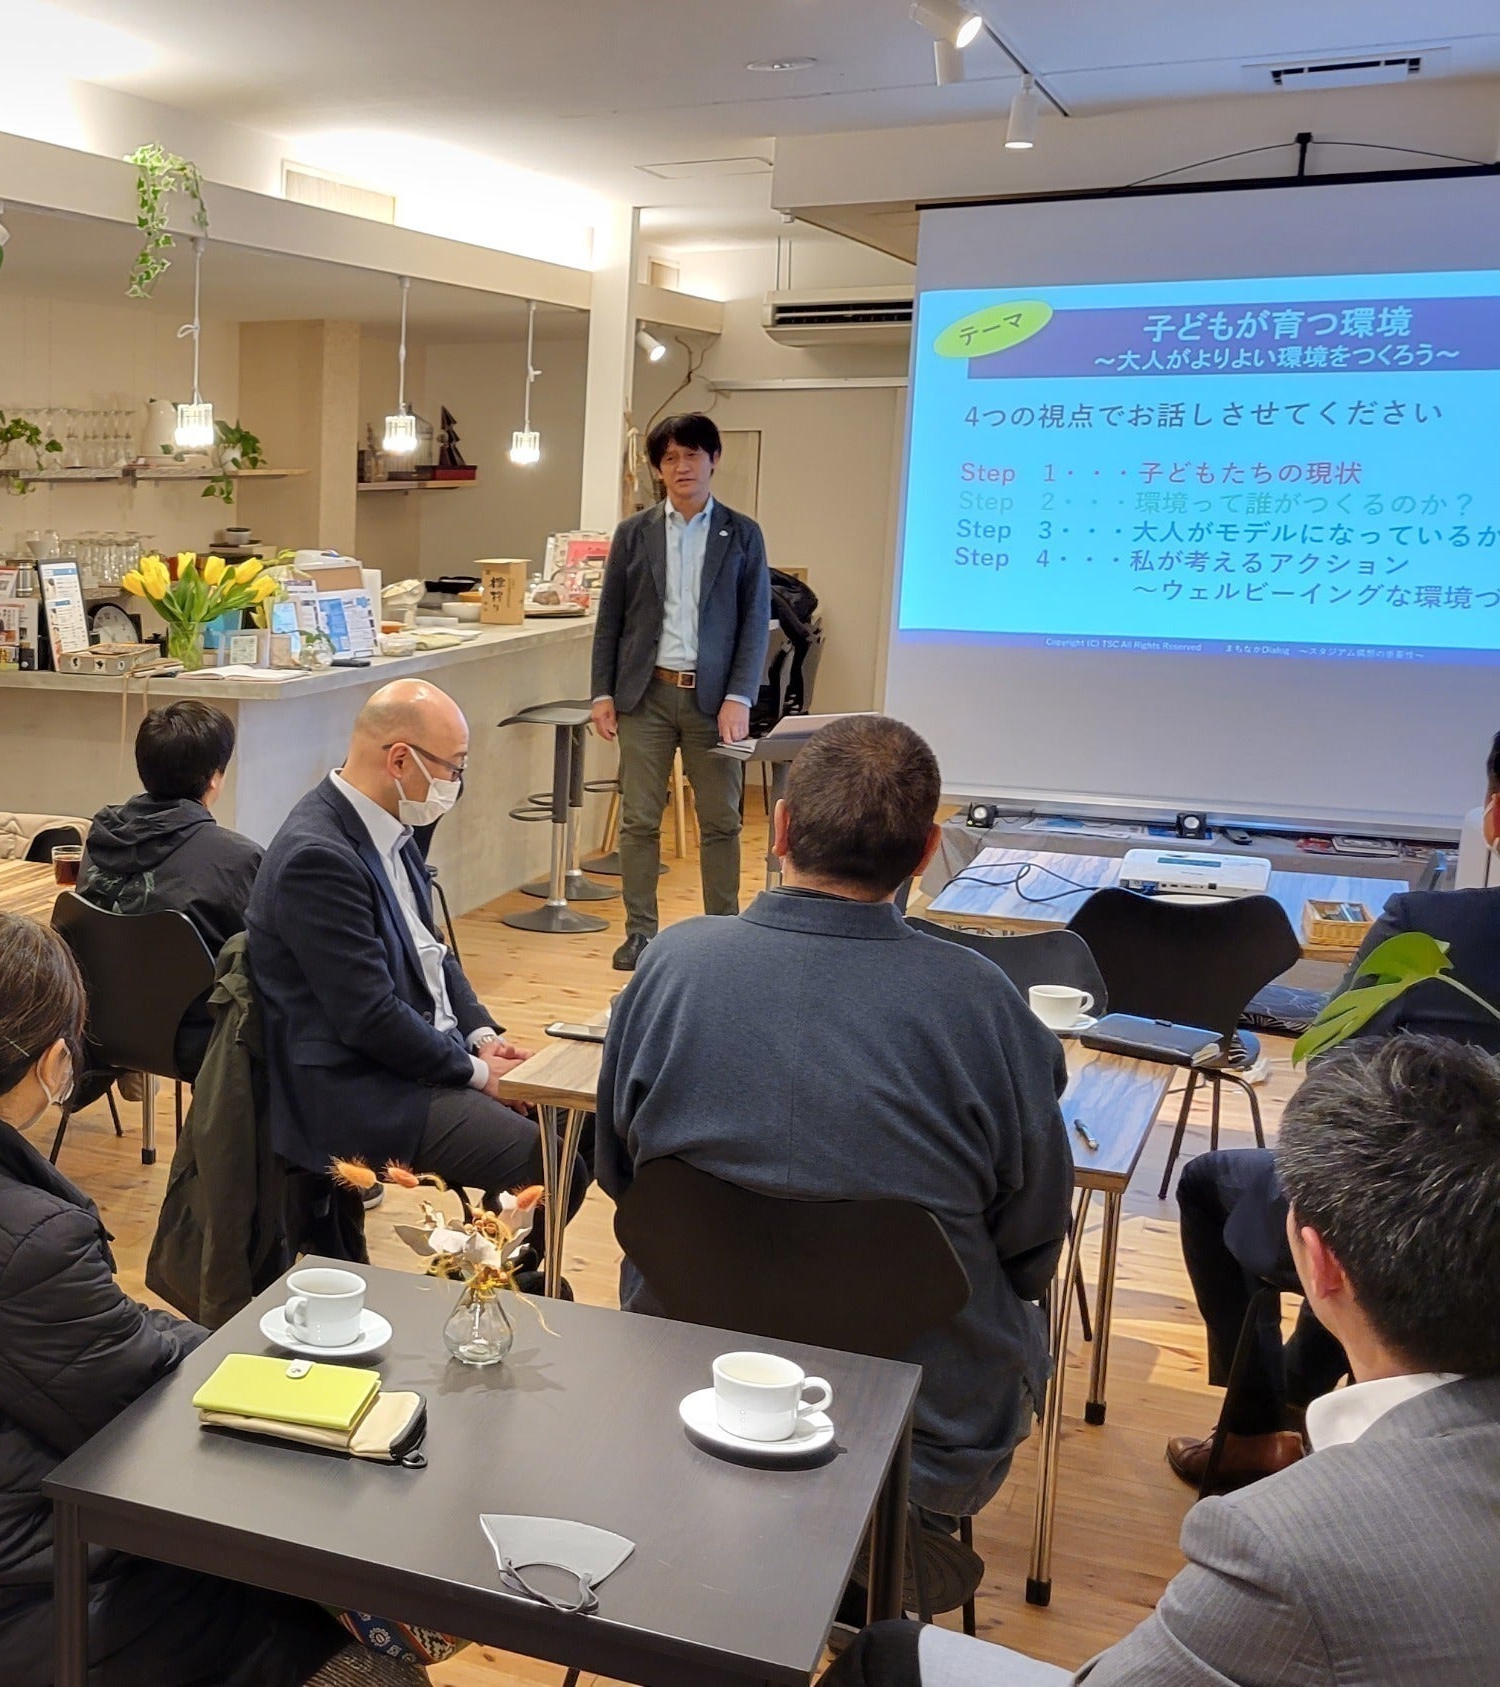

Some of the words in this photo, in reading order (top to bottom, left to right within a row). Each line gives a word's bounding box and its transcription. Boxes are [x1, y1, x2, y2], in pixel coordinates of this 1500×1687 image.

[959, 313, 1023, 346] テーマ
[1143, 306, 1414, 343] 子どもが育つ環境
[964, 400, 1443, 429] 4つの視点でお話しさせてください
[960, 462, 1016, 487] Step
[958, 490, 1014, 515] Step
[956, 518, 1012, 543] Step
[954, 546, 1010, 571] Step
